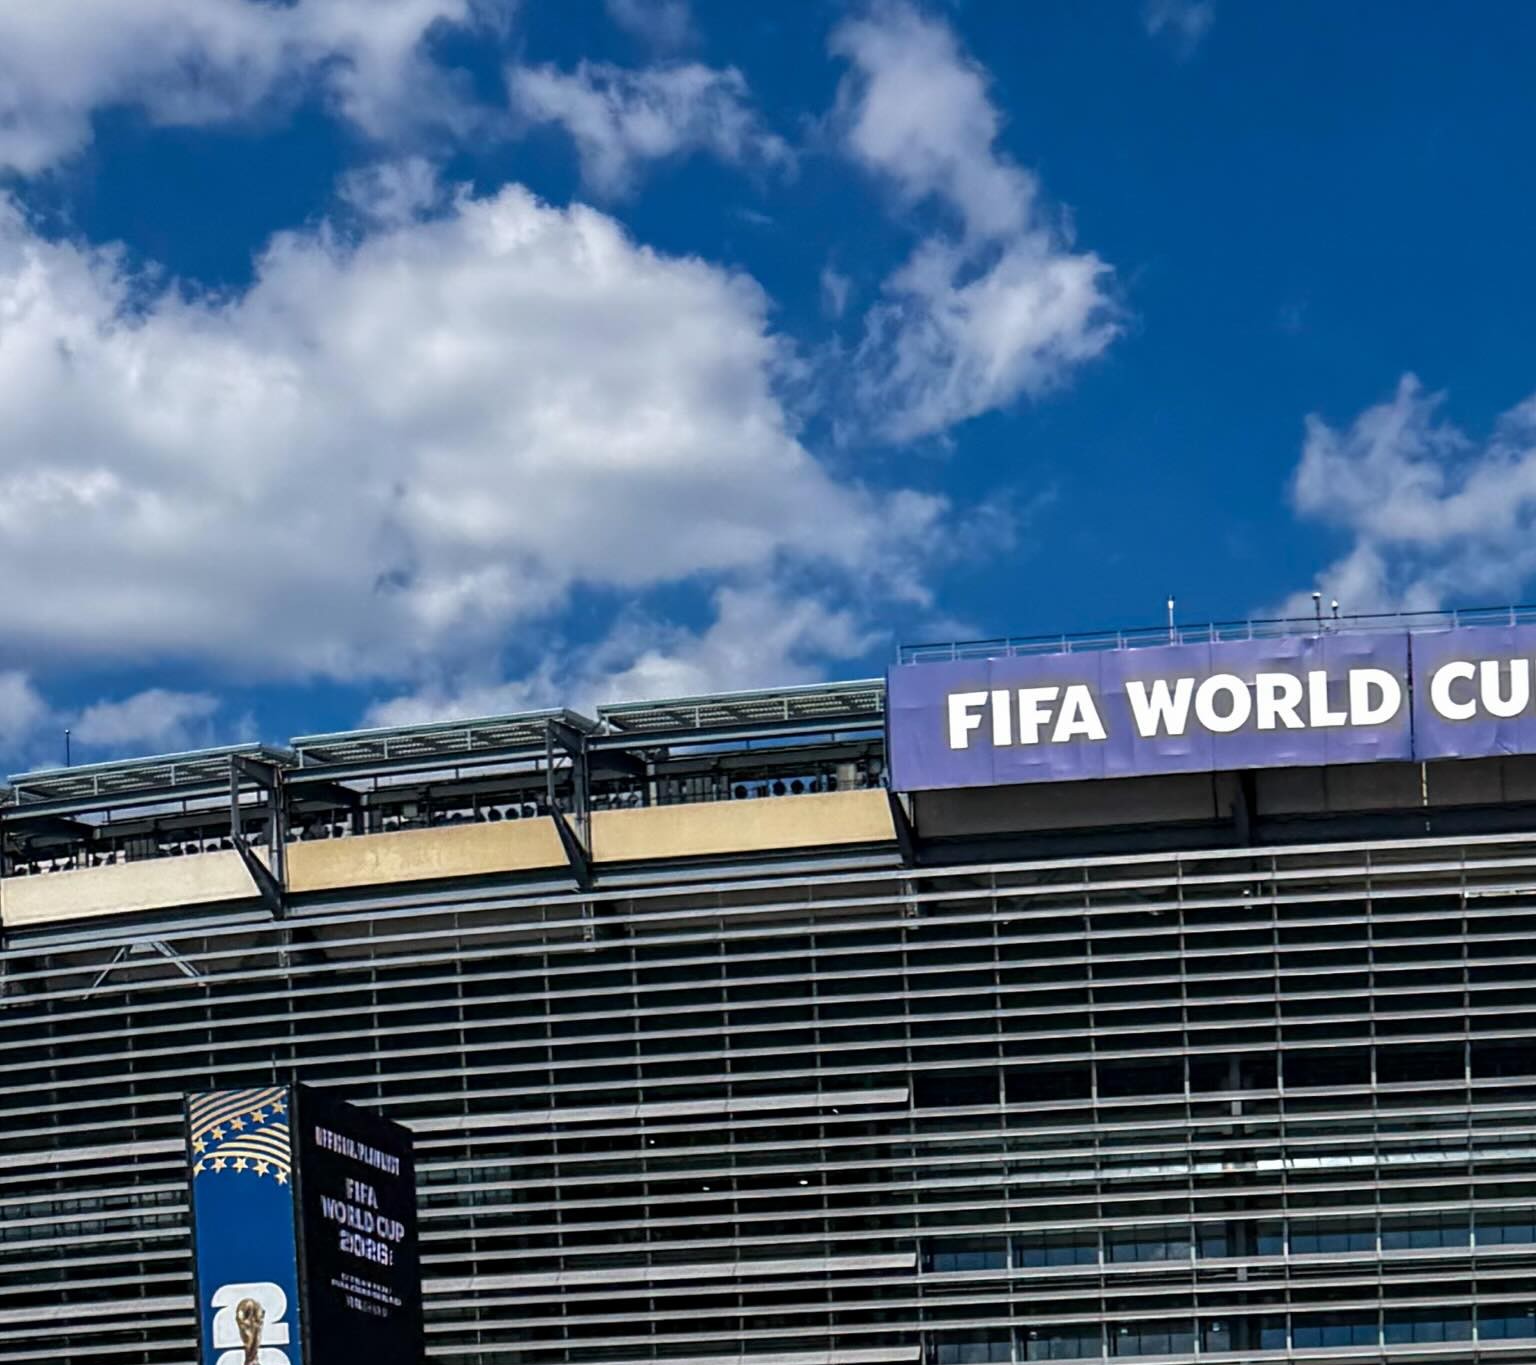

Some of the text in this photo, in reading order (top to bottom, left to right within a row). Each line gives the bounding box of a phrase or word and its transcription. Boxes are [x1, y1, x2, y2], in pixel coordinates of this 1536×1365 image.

[947, 684, 1106, 749] FIFA
[1137, 668, 1403, 737] WORLD
[345, 1178, 378, 1209] FIFA
[320, 1195, 405, 1243] WORLD CUP
